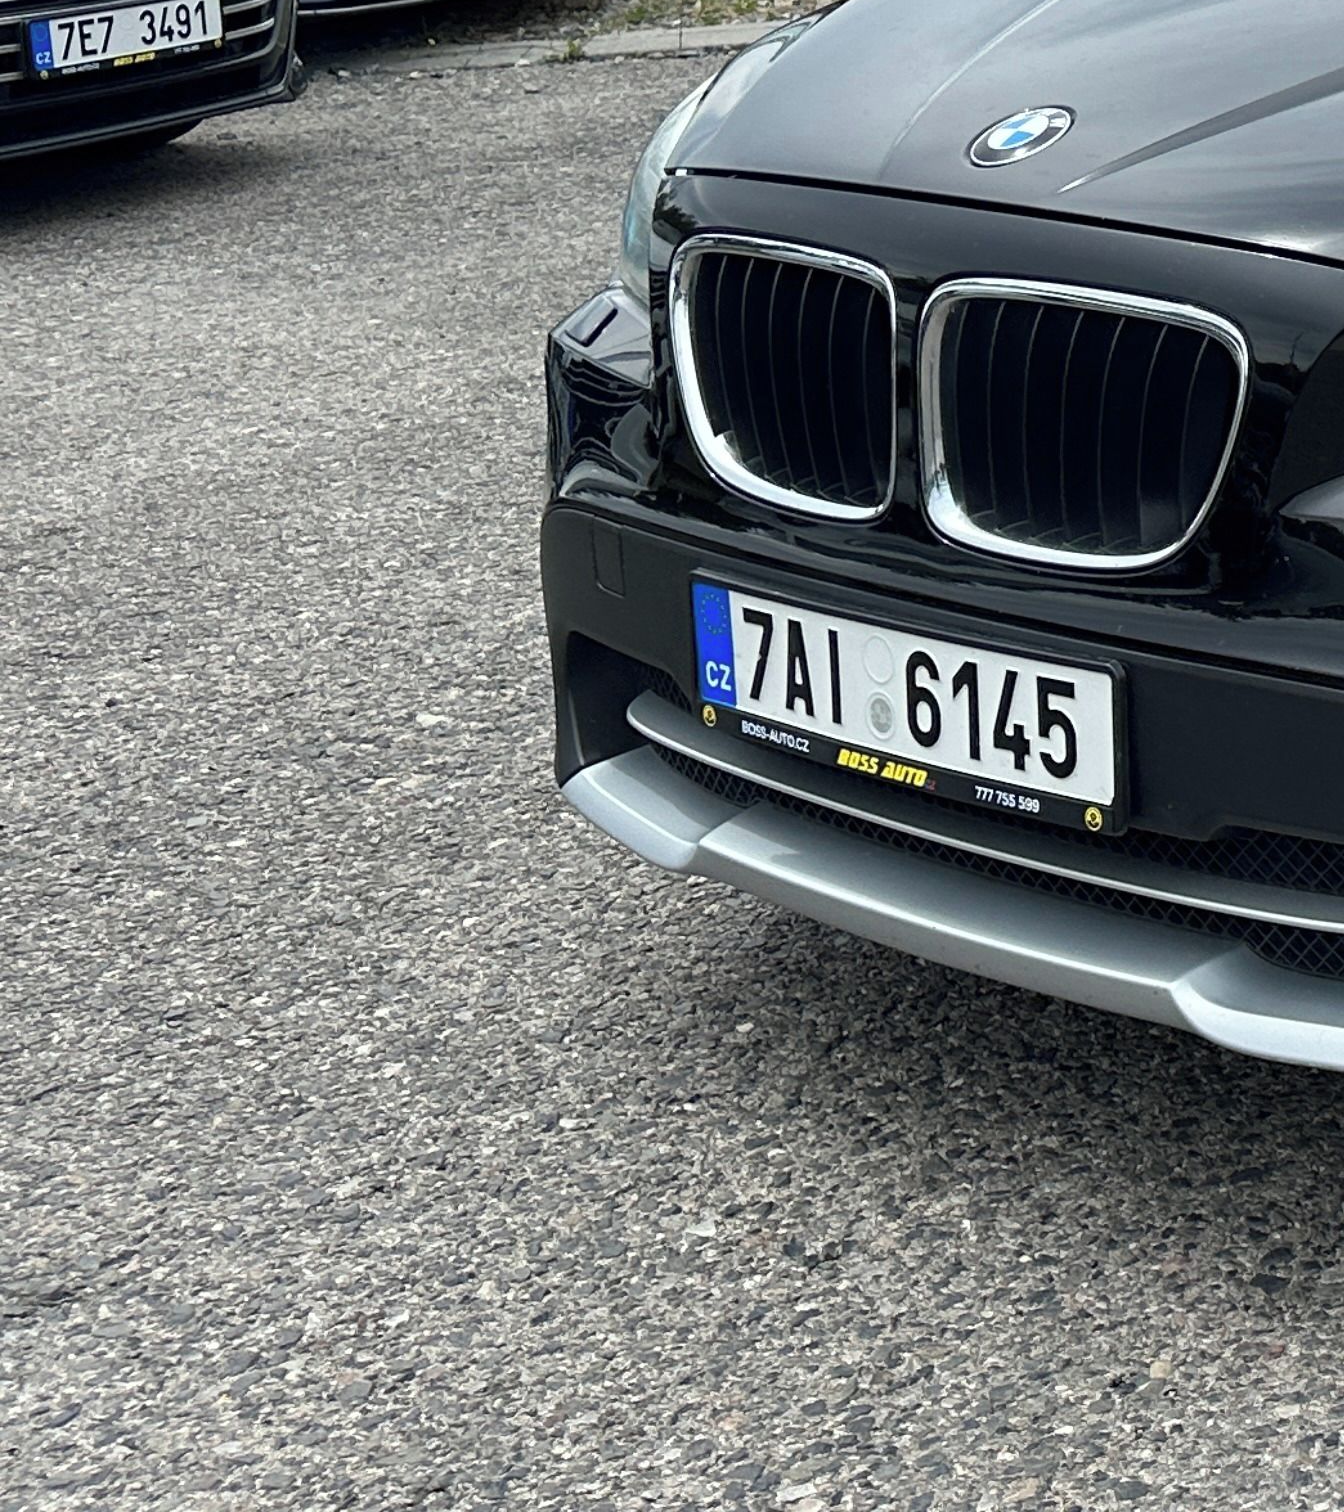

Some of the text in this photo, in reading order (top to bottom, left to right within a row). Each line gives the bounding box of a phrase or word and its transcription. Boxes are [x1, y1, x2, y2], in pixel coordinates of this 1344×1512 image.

[57, 0, 208, 61] 7E7 3491
[35, 51, 51, 65] CZ
[705, 659, 733, 692] CZ
[905, 649, 1079, 779] 6145
[741, 719, 810, 753] BOSS-AUTO.CZ
[836, 747, 880, 775] BOSS
[880, 761, 929, 788] AUTO
[974, 785, 995, 802] 777
[996, 790, 1017, 809] 755
